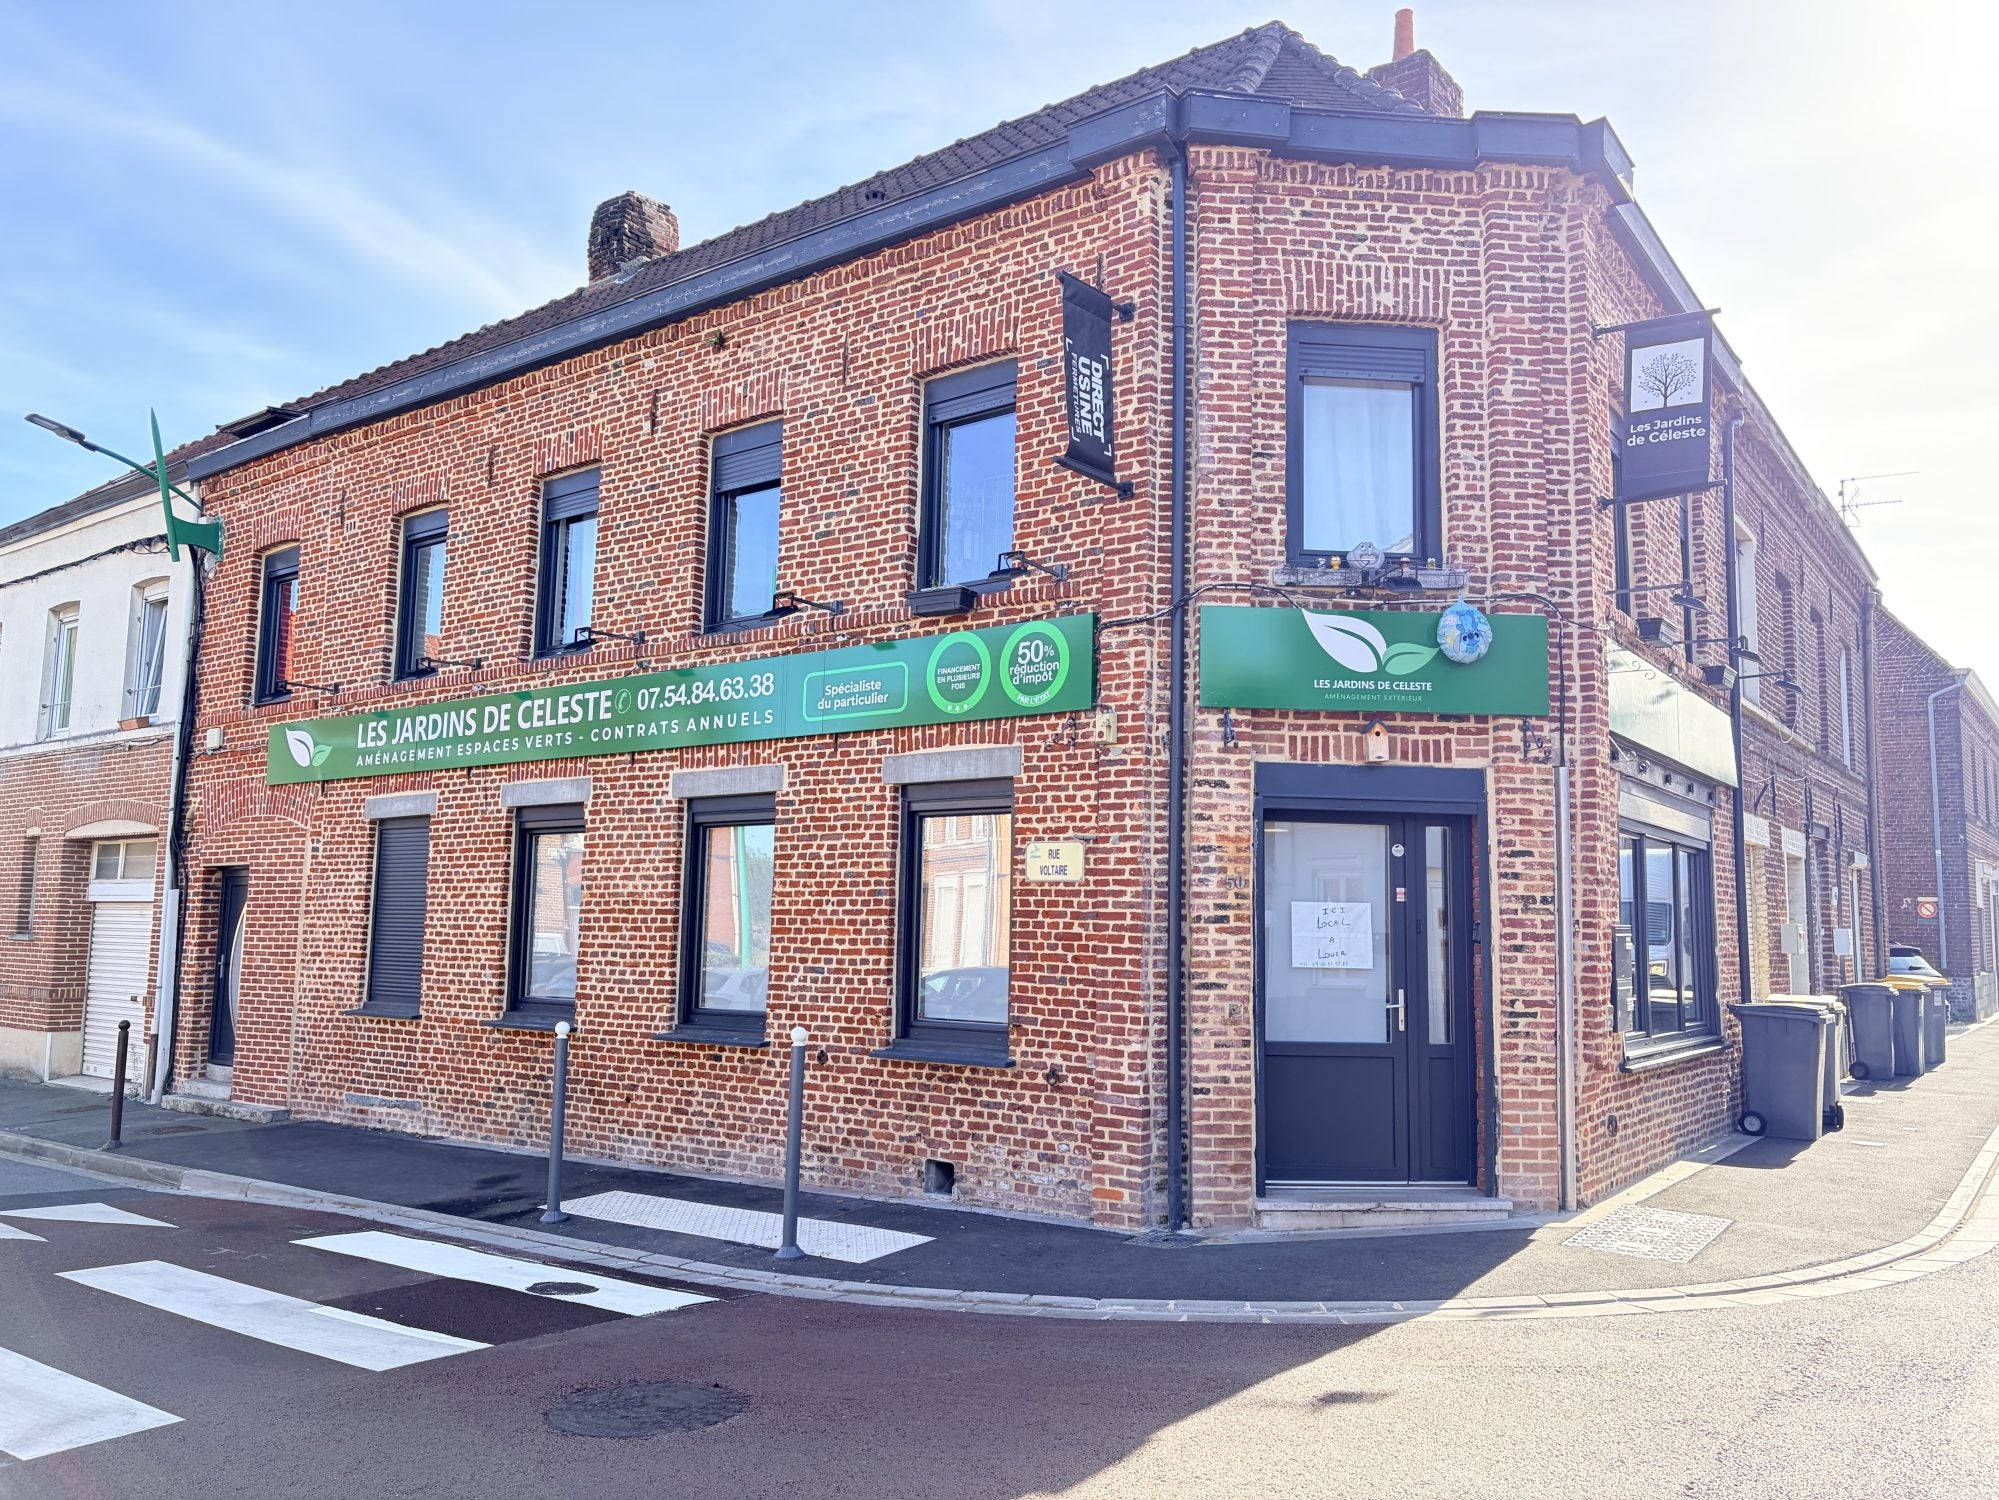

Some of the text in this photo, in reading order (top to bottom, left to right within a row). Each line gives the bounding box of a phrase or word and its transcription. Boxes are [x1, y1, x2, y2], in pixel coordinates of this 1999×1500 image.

[1071, 352, 1082, 434] FERMETURES
[1078, 356, 1093, 437] USINE
[1091, 361, 1105, 444] DIRECT
[1630, 415, 1702, 434] Les Jardins
[1627, 426, 1706, 447] de Céleste
[1018, 640, 1055, 664] 50%
[937, 663, 981, 675] FINANCEMENT
[1009, 660, 1060, 676] réduction
[937, 672, 981, 684] EN PLUSIEURS
[1012, 670, 1053, 685] d'impôt
[1314, 679, 1433, 691] LES JARDINS DE CELESTE
[825, 680, 882, 697] Spécialiste
[951, 682, 966, 690] FOIS
[818, 692, 889, 711] du particulier
[357, 672, 775, 749] LES JARDINS DE CELESTE 07.54.84.63.38
[356, 745, 453, 767] AMÉNAGEMENT
[457, 737, 519, 756] ESPACES
[525, 731, 572, 749] VERTS
[591, 719, 680, 742] CONTRATS
[686, 709, 774, 732] ANNUELS
[1048, 848, 1061, 860] RUE
[1039, 864, 1068, 876] VOLTAIRE
[1322, 907, 1347, 915] ICI
[1317, 916, 1351, 930] LOCAL
